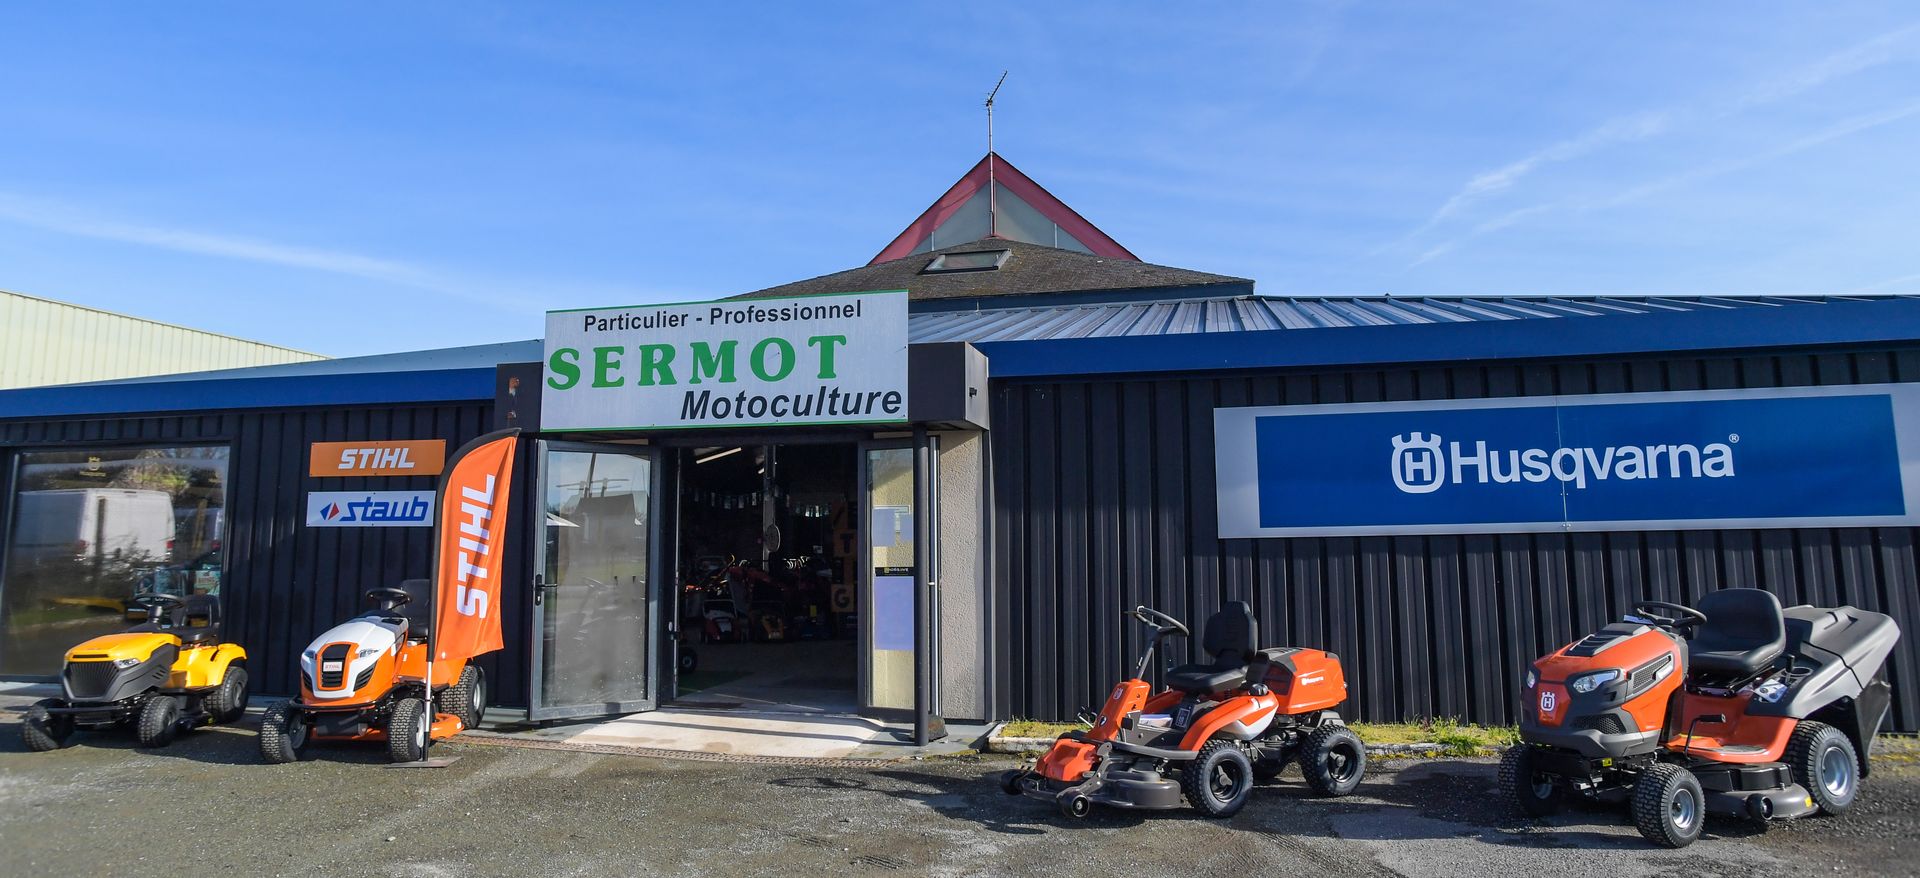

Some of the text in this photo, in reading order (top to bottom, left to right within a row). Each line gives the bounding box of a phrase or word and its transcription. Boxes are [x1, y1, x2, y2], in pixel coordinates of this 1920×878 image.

[583, 310, 688, 332] Particulier
[710, 299, 862, 326] Professionnel
[547, 334, 847, 390] SERMOT
[680, 385, 902, 420] Motoculture
[338, 447, 415, 469] STIHL
[339, 496, 429, 522] staub
[456, 474, 496, 619] STIHL
